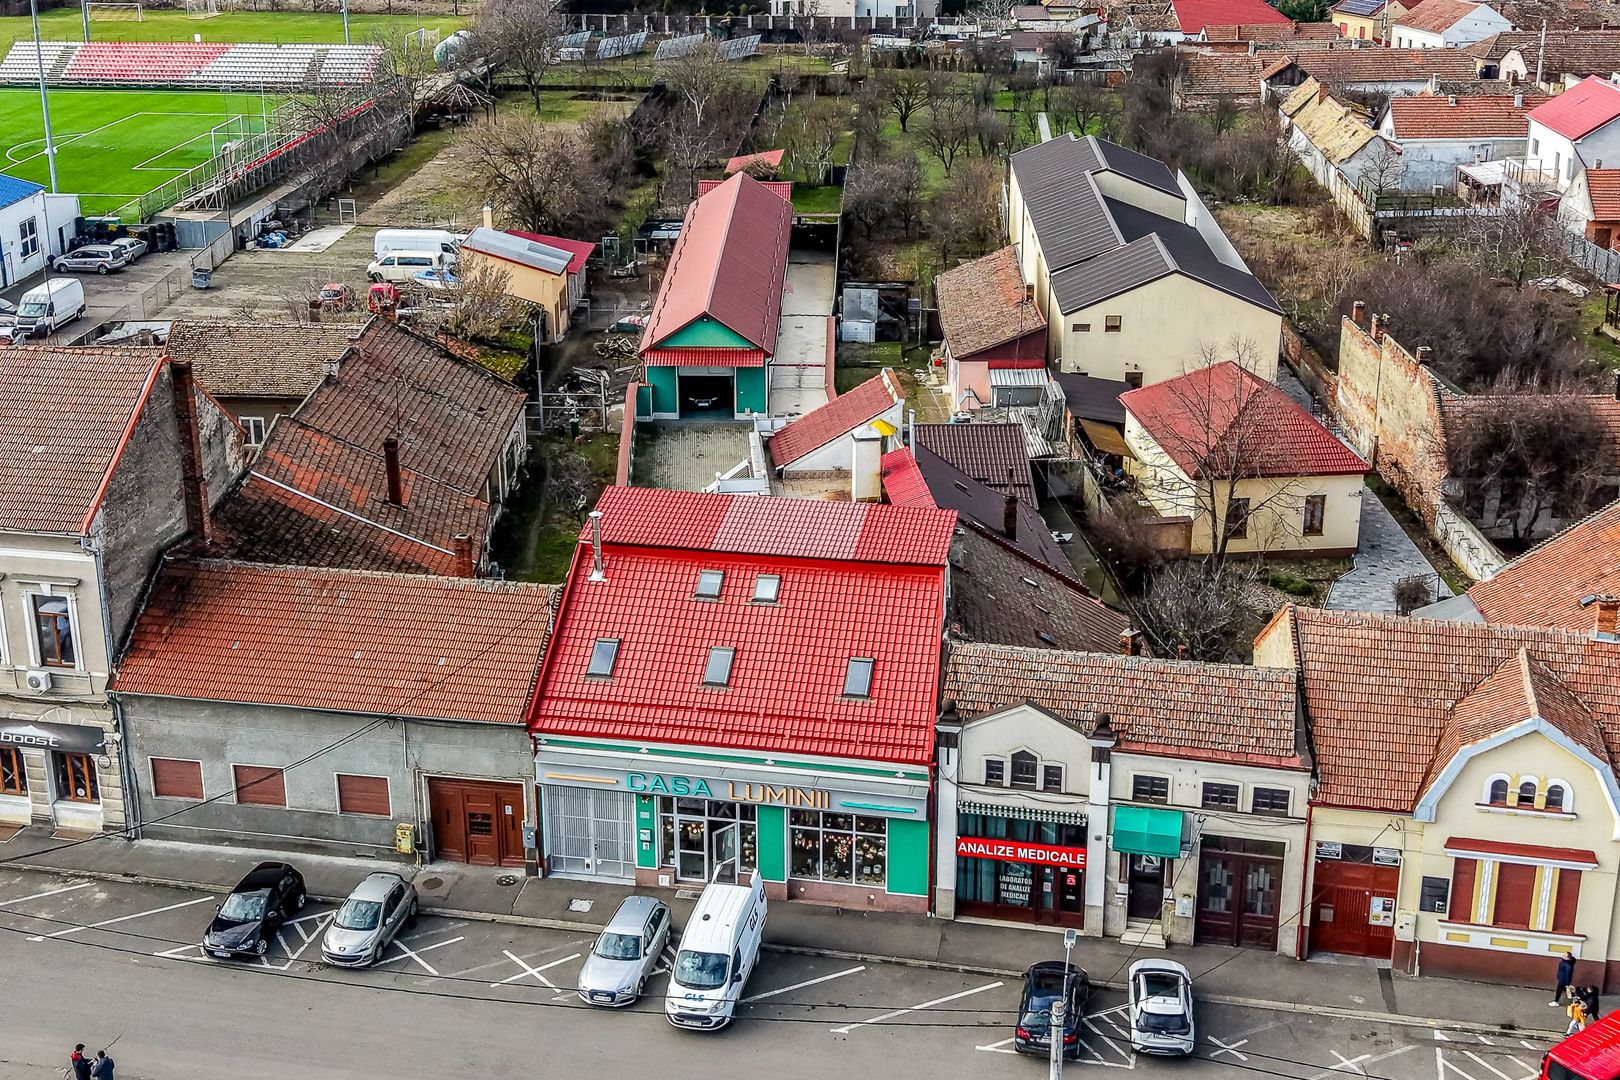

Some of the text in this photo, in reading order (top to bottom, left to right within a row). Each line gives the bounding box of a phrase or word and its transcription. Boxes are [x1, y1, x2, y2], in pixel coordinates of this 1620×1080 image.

[1, 731, 59, 747] boost
[627, 773, 830, 810] CASA LUMINII
[958, 842, 1085, 865] ANALIZE MEDICALE
[1001, 891, 1029, 901] MEDICALE
[1008, 884, 1031, 893] ANALIZE
[749, 907, 759, 932] GLS
[684, 993, 705, 1003] GLS
